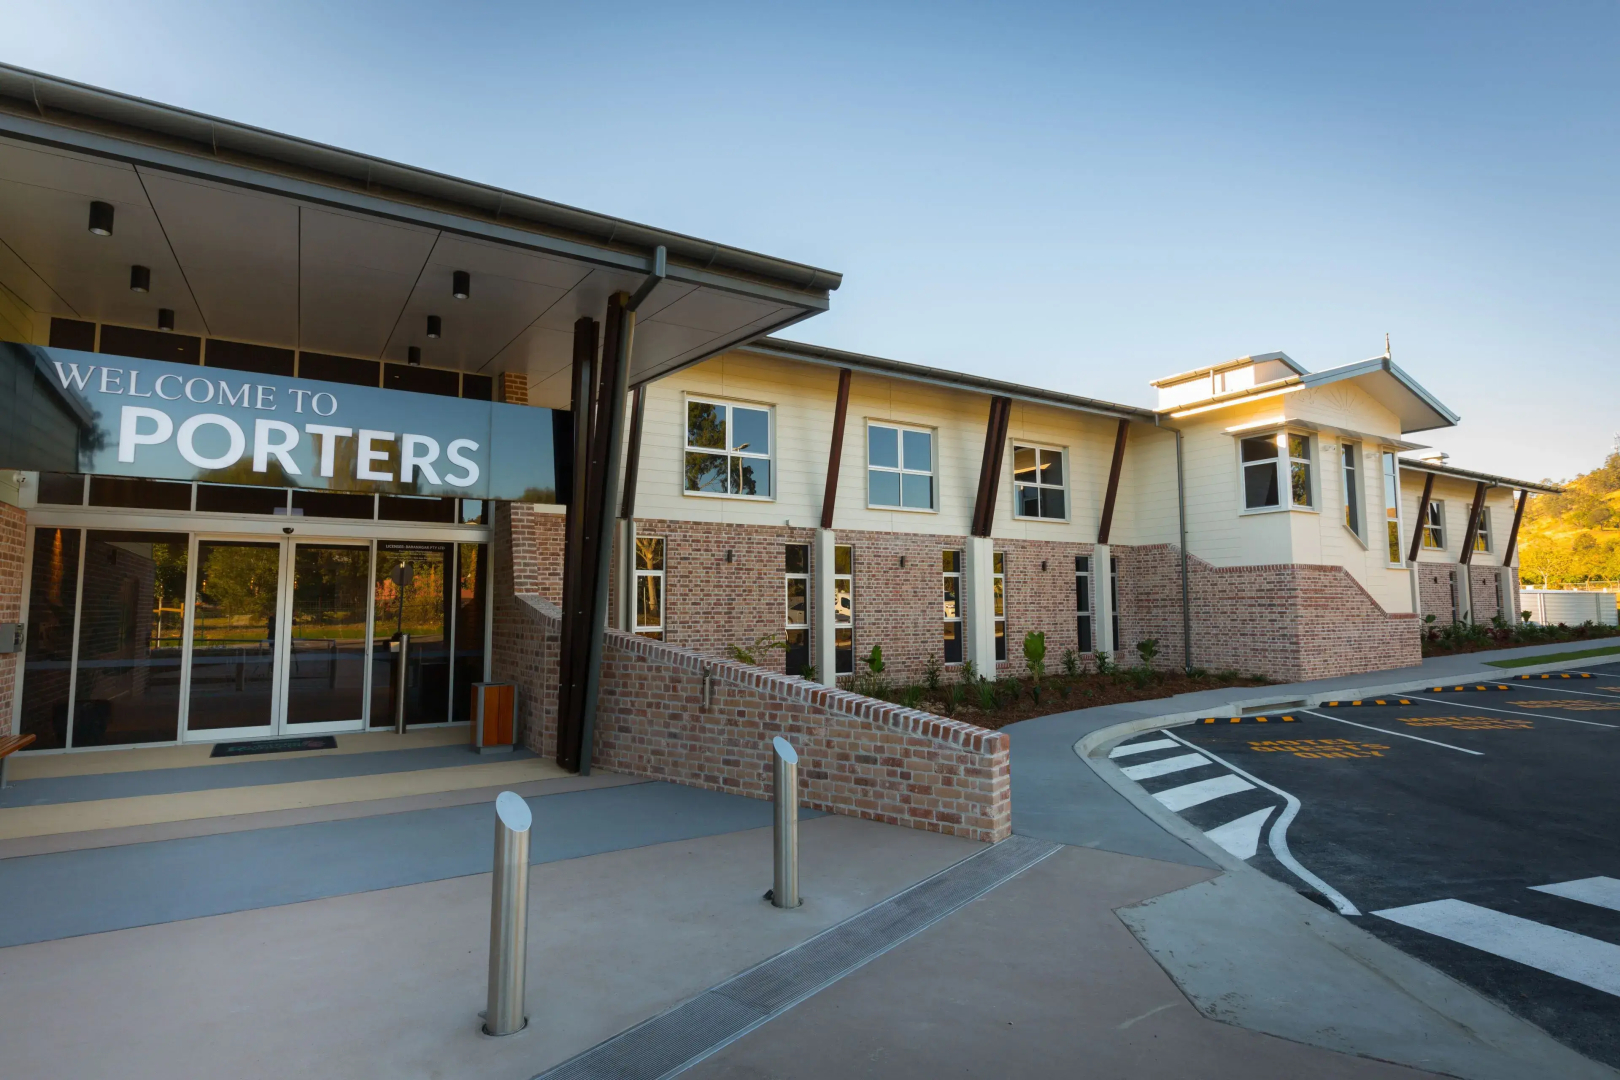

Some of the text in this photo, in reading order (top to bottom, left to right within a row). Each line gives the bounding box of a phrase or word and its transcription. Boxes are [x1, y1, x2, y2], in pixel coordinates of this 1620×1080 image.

[52, 361, 338, 416] WELCOME TO
[118, 405, 480, 487] PORTERS
[1246, 738, 1362, 746] MOTEL
[1250, 743, 1391, 752] GUESTS
[1293, 750, 1385, 758] ONLY
